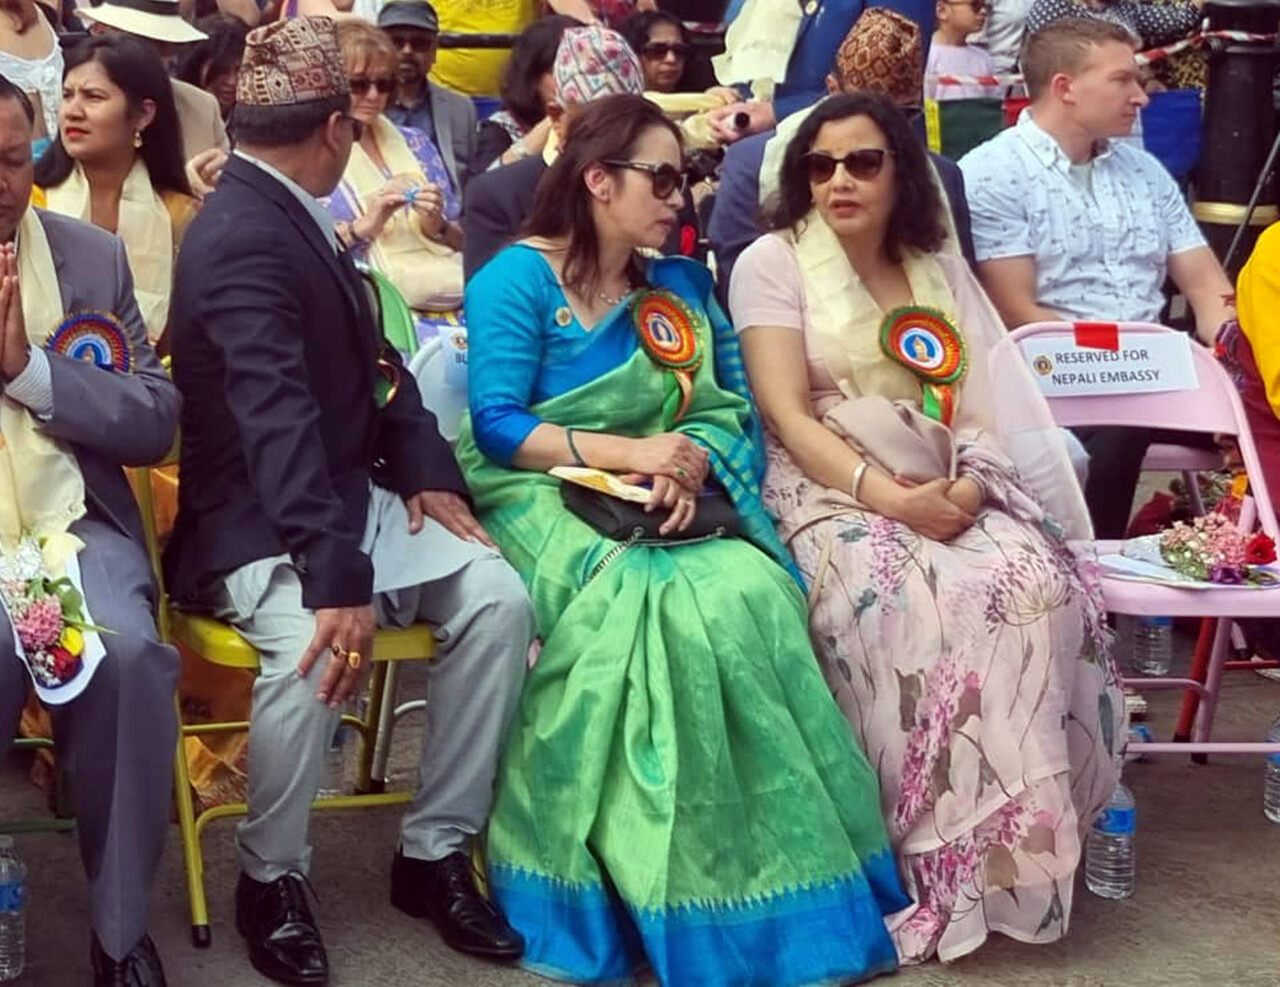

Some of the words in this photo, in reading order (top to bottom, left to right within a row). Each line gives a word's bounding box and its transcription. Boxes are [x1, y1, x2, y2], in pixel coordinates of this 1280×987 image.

[1055, 351, 1119, 364] RESERVED
[1123, 349, 1149, 361] FOR
[1052, 373, 1097, 385] NEPALI
[1100, 370, 1161, 383] EMBASSY
